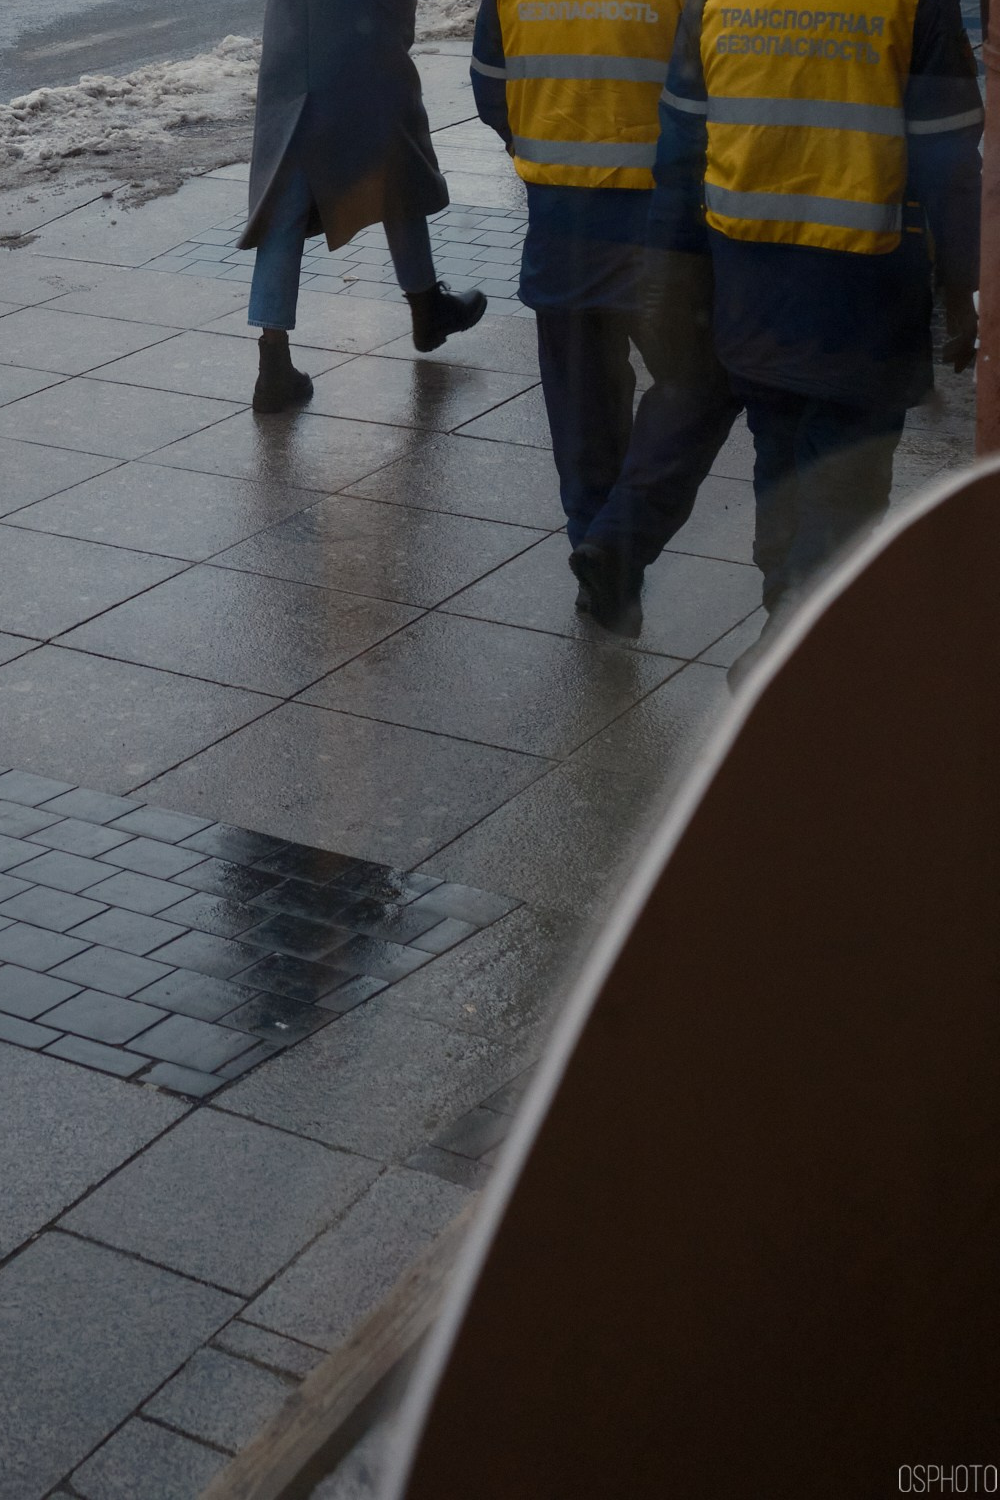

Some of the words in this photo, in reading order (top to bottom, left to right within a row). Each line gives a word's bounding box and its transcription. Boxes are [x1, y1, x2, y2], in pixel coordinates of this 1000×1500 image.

[518, 0, 659, 24] БЕЗОПАСНОСТЬ
[720, 8, 886, 37] ТРАНСПОРТНАЯ
[716, 33, 881, 65] БЕЗОПАСНОСТЬ
